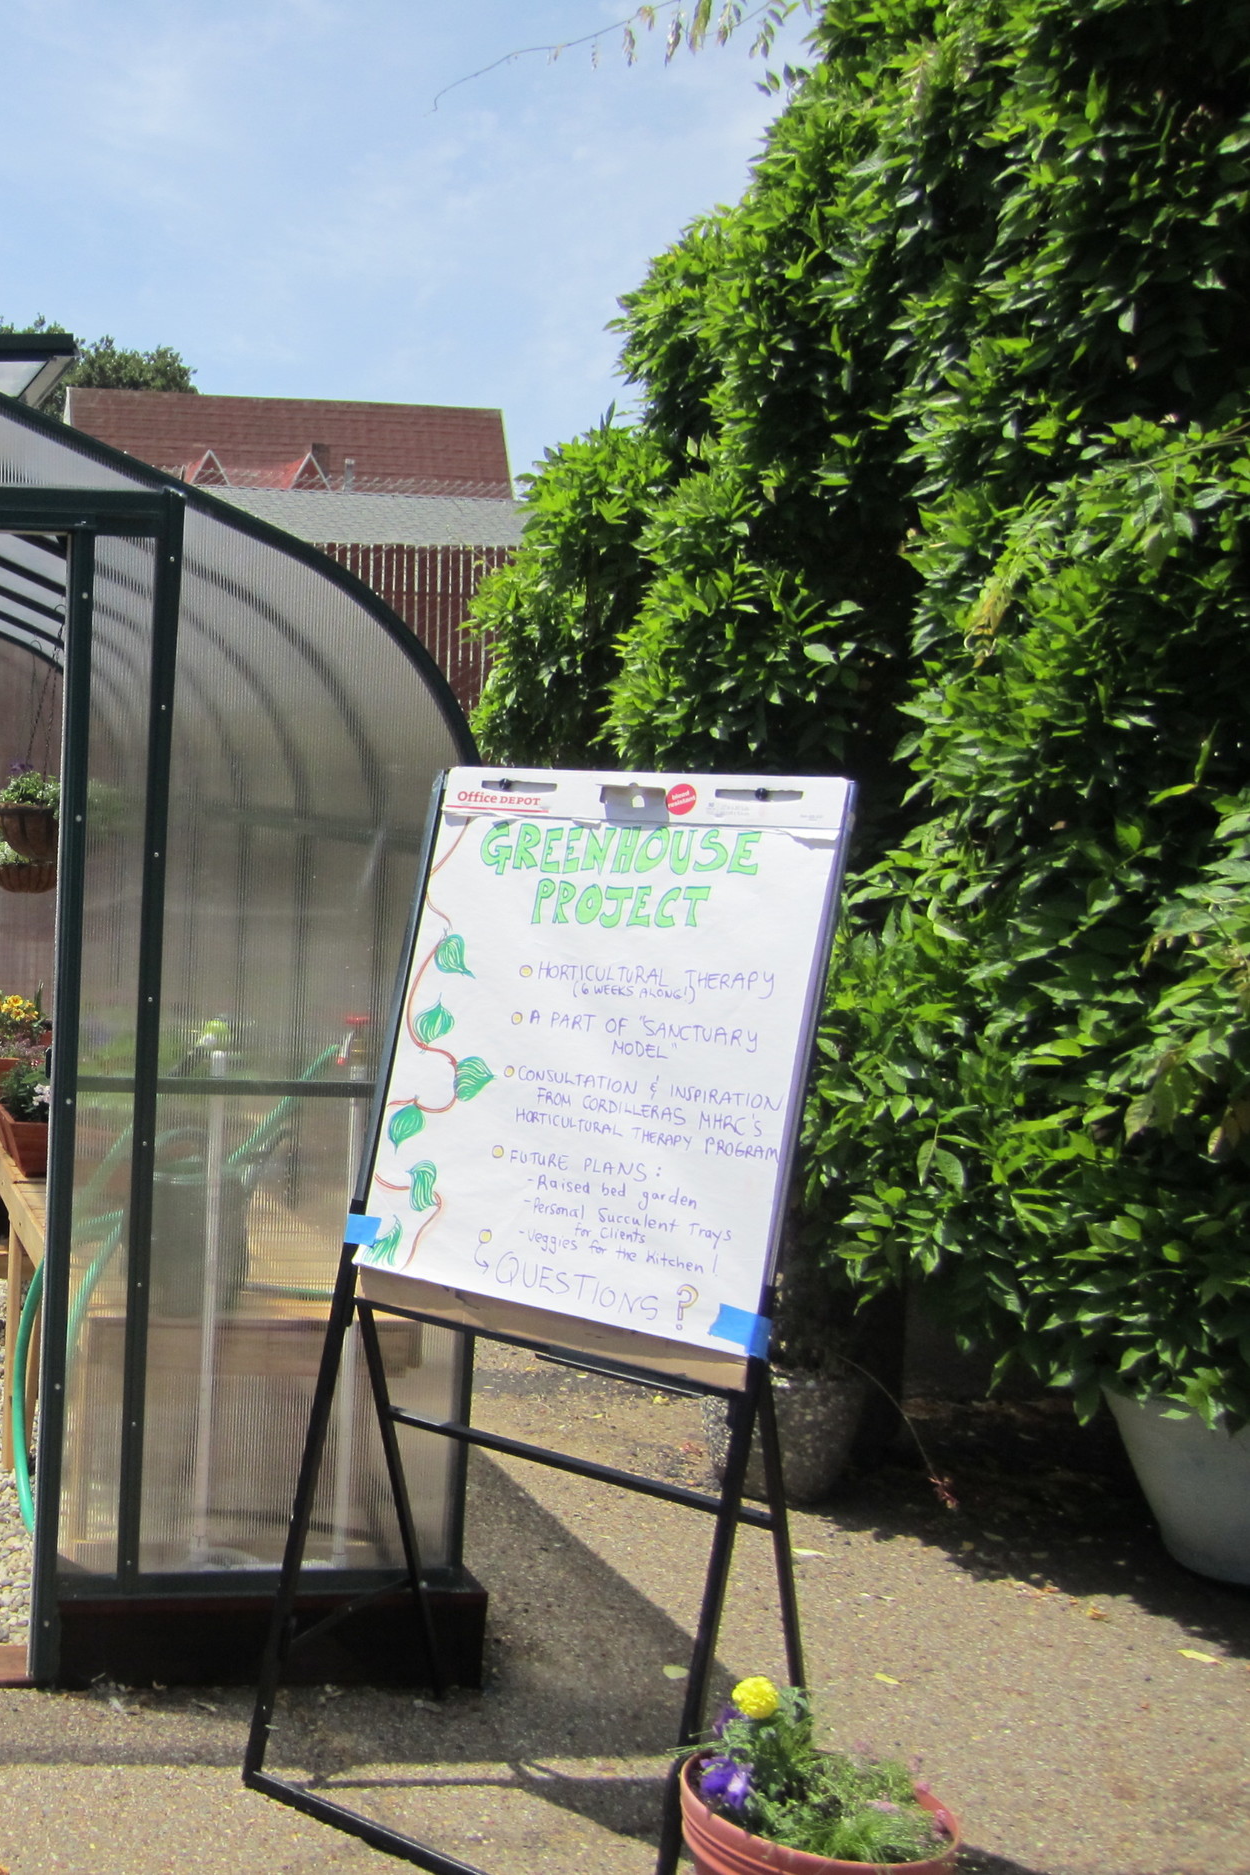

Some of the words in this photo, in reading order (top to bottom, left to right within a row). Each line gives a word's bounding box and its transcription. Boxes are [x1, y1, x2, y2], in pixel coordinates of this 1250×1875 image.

[457, 791, 498, 803] Office
[499, 796, 541, 806] DEPOT
[668, 795, 696, 809] resistant
[671, 790, 690, 801] bleed
[480, 821, 762, 875] GREENHOUSE
[531, 878, 711, 928] PROJECT
[538, 961, 669, 987] HORTICULTURAL
[684, 969, 775, 1000] THERAPY
[594, 984, 634, 997] WEEKS
[639, 986, 696, 1005] ALONG!)
[529, 1009, 540, 1024] A
[550, 1012, 596, 1032] PART
[605, 1017, 629, 1036] OF
[639, 1015, 758, 1053] "SANCTUARY
[518, 1065, 638, 1095] CONSULTATION
[670, 1083, 784, 1112] INSPIRATION
[537, 1087, 571, 1107] FROM
[583, 1095, 686, 1126] CORDILLERAS
[515, 1108, 623, 1137] HORTICULTURAL
[632, 1127, 693, 1150] THERAPY
[705, 1136, 780, 1163] PROGRAM
[509, 1150, 569, 1171] FUTURE
[601, 1182, 626, 1198] bed
[637, 1187, 697, 1211] garden
[575, 1223, 592, 1238] for
[600, 1226, 646, 1244] Clients
[598, 1207, 679, 1233] Succulent
[689, 1222, 732, 1250] Trays
[589, 1240, 608, 1256] for
[615, 1247, 637, 1262] the
[496, 1251, 659, 1321] QUESTIONS
